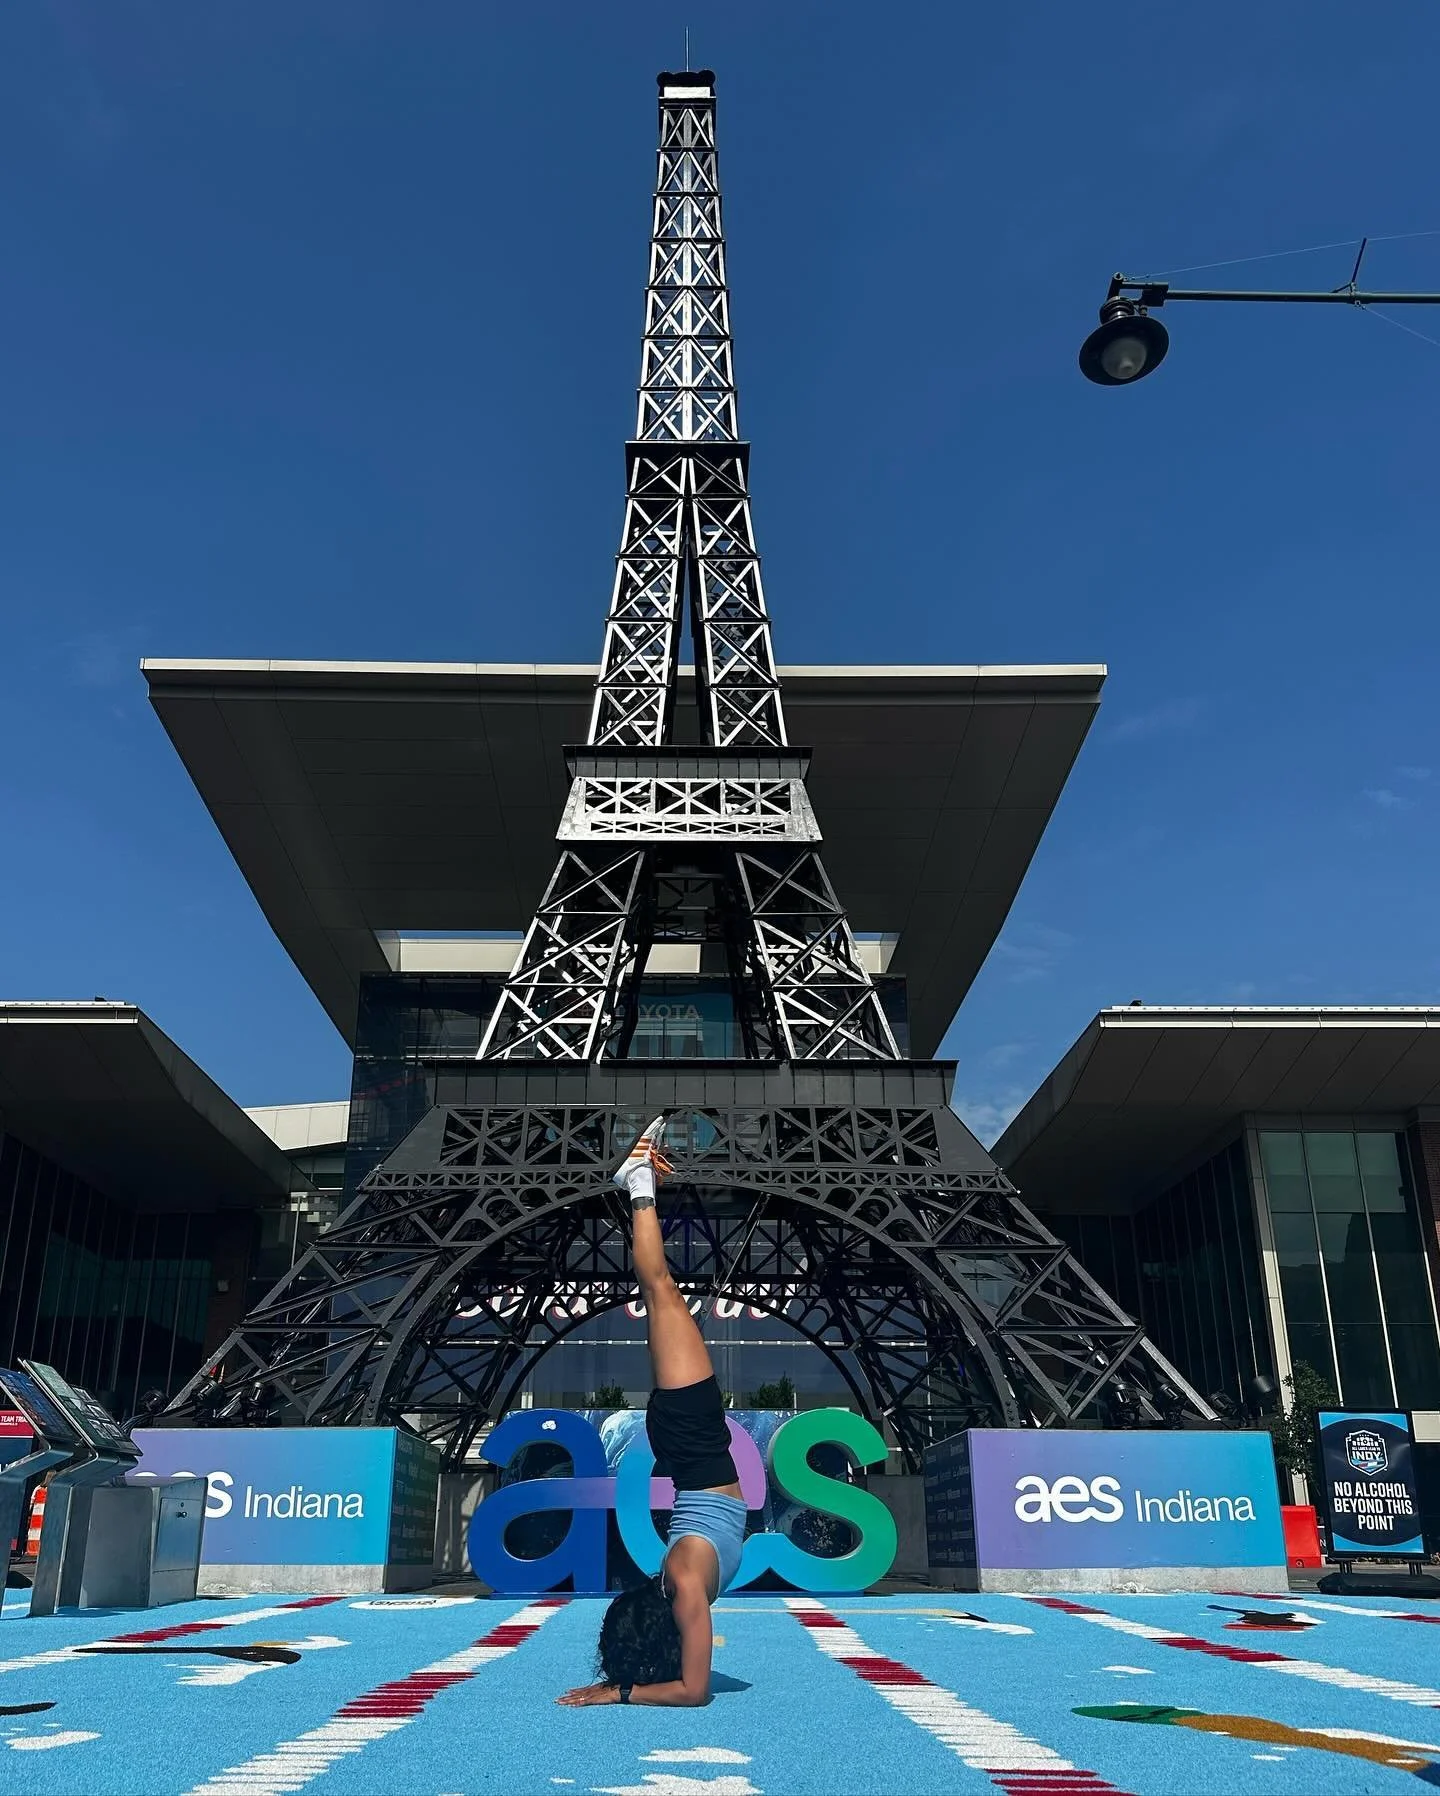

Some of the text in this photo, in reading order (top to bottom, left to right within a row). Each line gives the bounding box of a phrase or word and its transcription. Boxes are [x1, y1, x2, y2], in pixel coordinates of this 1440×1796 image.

[1352, 1451, 1381, 1461] INDY
[1333, 1481, 1410, 1498] NO ALCOHOL
[244, 1486, 364, 1519] Indiana
[1014, 1475, 1256, 1523] aes Indiana
[1333, 1498, 1413, 1515] BEYOND THIS
[1357, 1515, 1394, 1531] POINT
